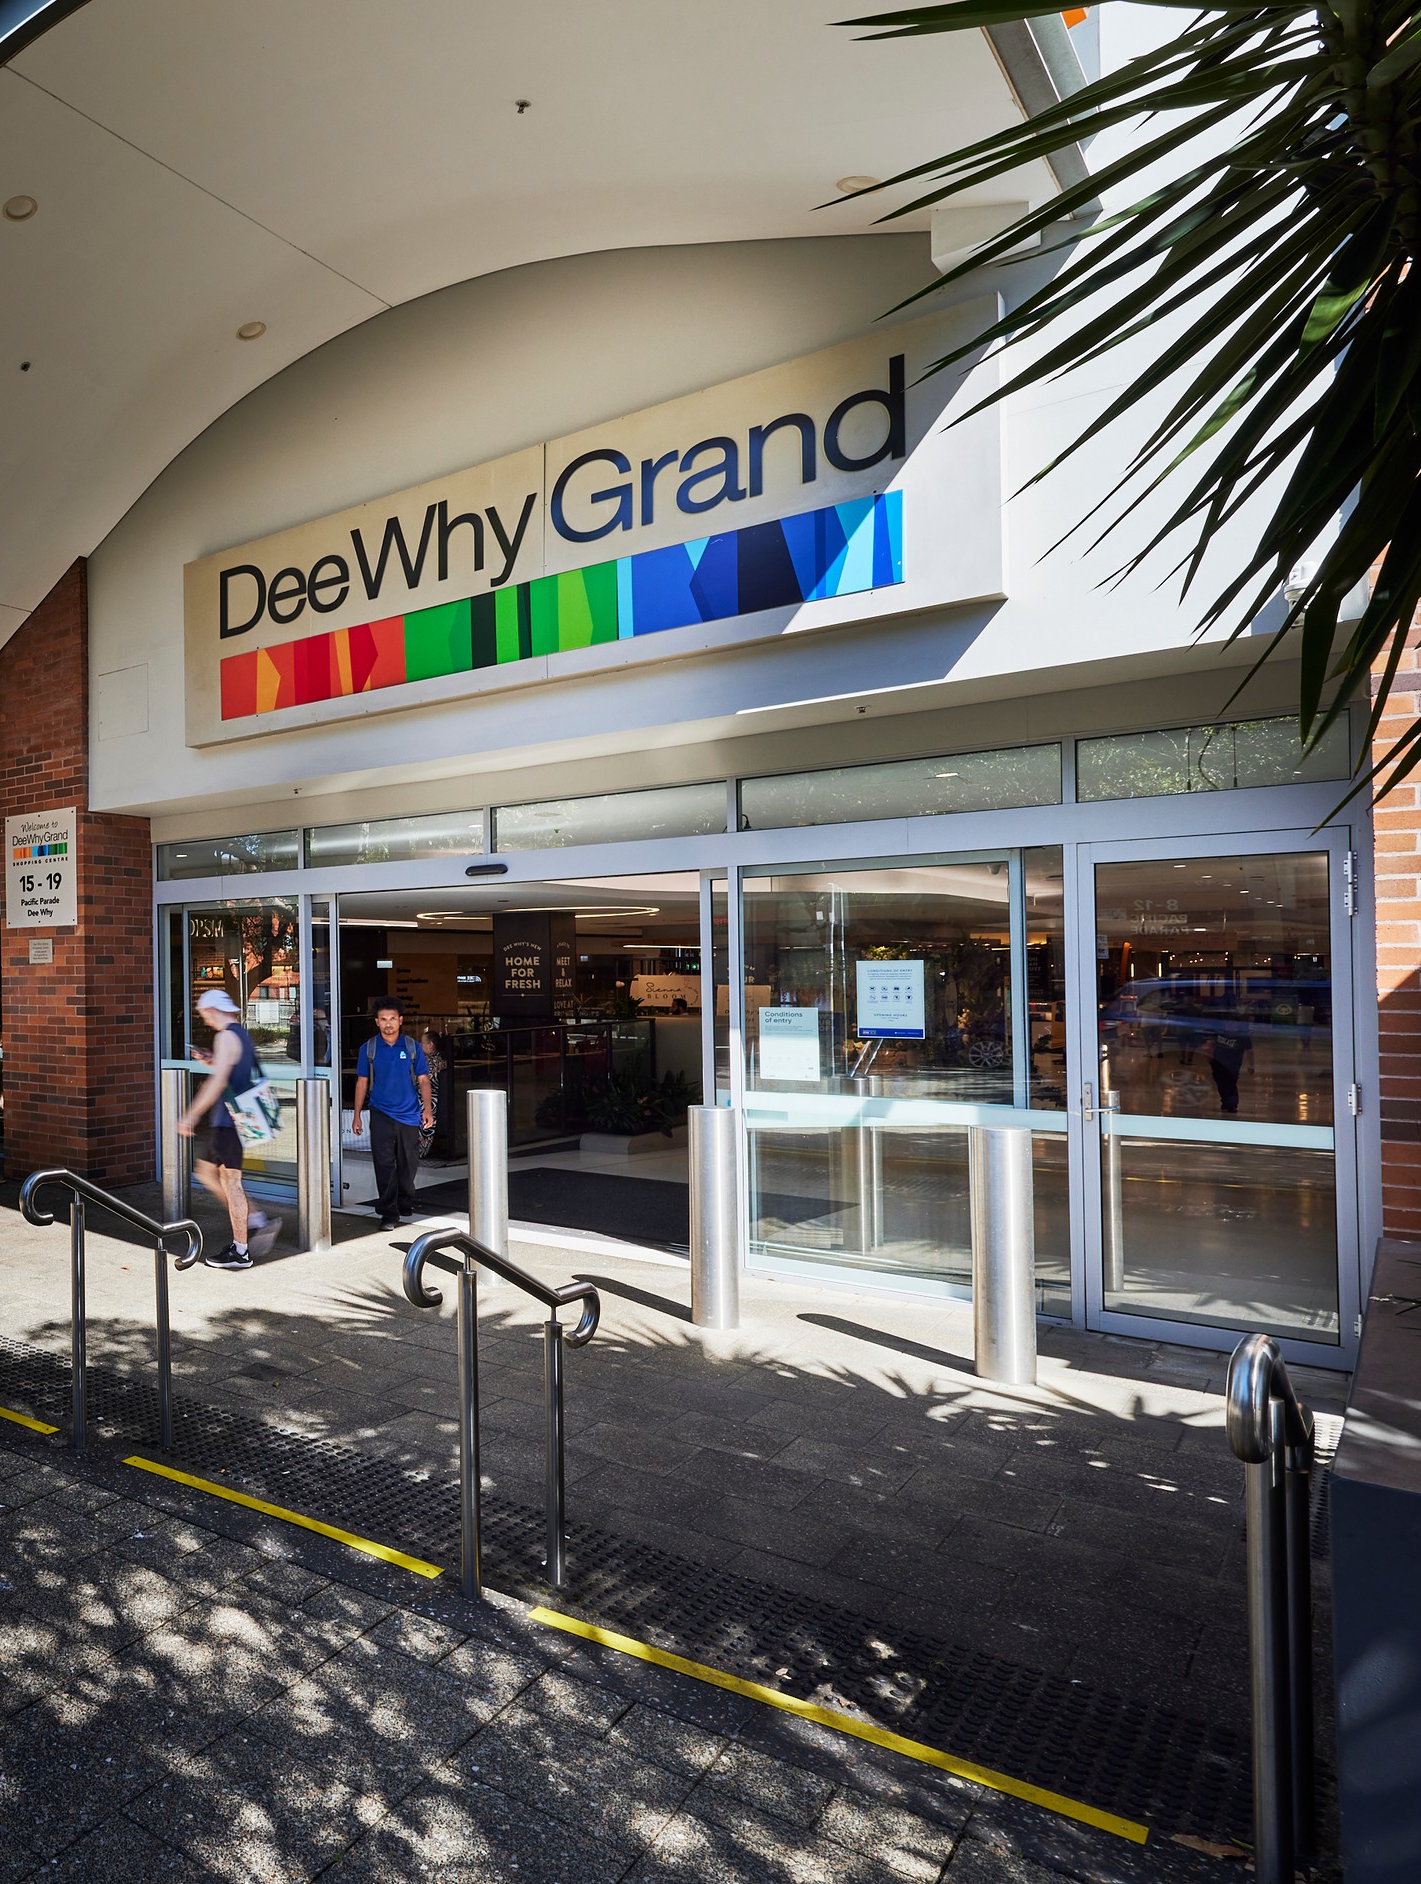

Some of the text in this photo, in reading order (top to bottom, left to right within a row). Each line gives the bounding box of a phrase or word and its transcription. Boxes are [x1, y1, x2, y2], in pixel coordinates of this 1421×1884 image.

[21, 820, 59, 833] Welcome to
[12, 856, 69, 867] SHOPPING CENTRE
[19, 875, 35, 892] 15
[46, 872, 62, 890] 19
[20, 896, 60, 906] Pacific Parade
[27, 908, 53, 917] Dee Why
[503, 944, 513, 952] DEE
[530, 943, 542, 951] NEW
[505, 956, 540, 966] HOME
[556, 956, 570, 966] MEET
[511, 968, 534, 977] FOR
[561, 968, 566, 976] &
[505, 979, 540, 989] FRESH
[555, 978, 572, 988] RELAX
[645, 981, 682, 993] Sienna
[554, 1000, 566, 1009] LOVE
